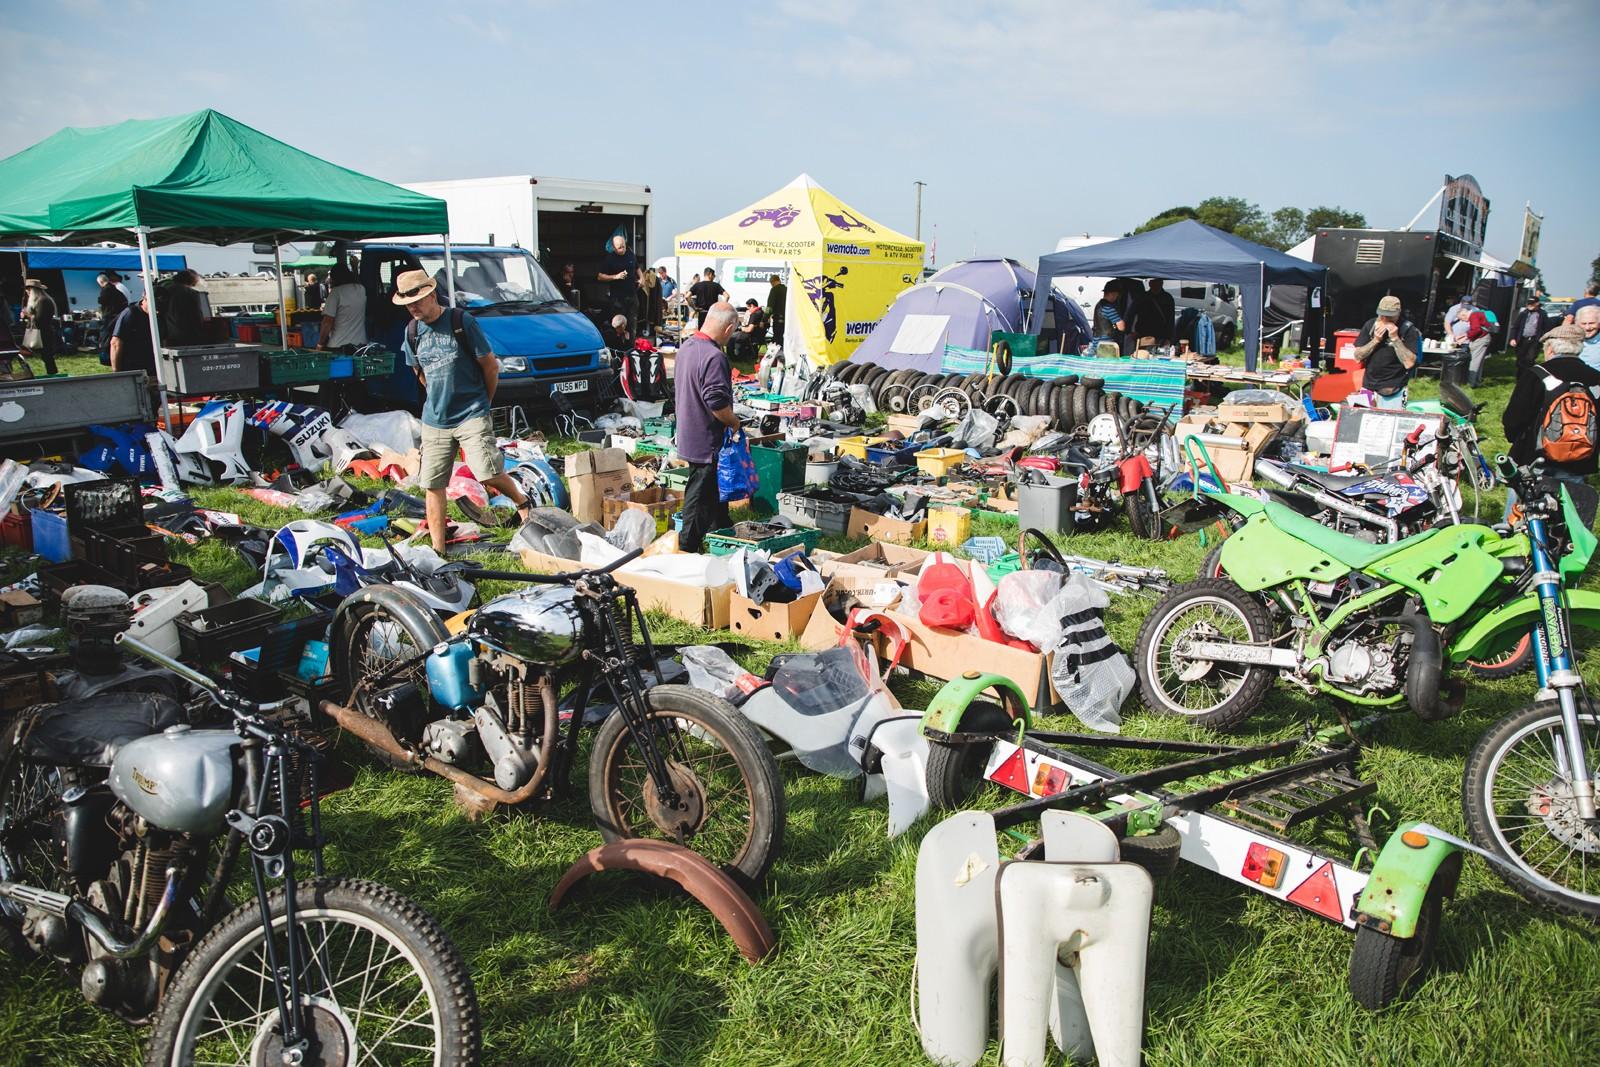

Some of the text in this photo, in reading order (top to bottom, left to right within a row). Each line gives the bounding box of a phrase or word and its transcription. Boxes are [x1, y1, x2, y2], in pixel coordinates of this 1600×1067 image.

[679, 239, 734, 251] wemoto.com
[787, 240, 816, 248] SCOOTER
[827, 243, 870, 255] wemoto.com
[296, 416, 330, 447] SUZUKI
